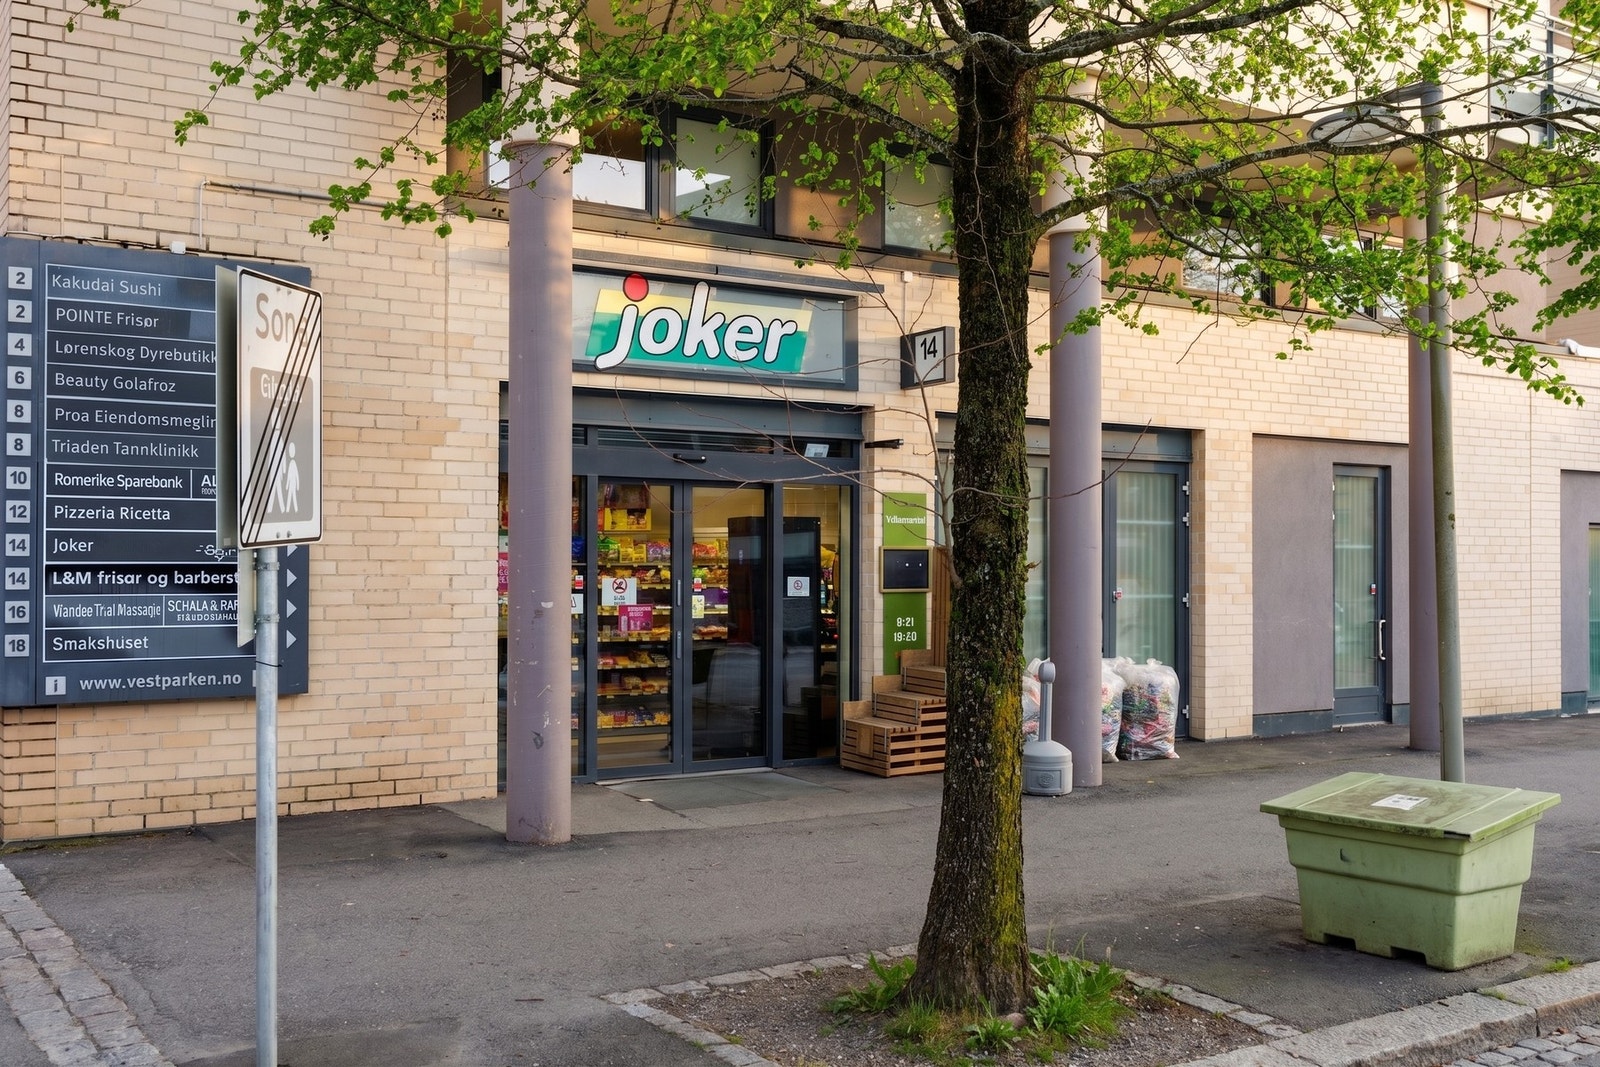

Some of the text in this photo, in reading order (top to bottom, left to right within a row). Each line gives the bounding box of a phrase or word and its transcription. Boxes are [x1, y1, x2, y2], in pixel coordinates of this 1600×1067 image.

[15, 271, 26, 285] 2
[52, 274, 162, 297] Kakudai Sushi
[15, 304, 26, 319] 2
[56, 307, 112, 325] POINTE
[594, 273, 798, 370] joker
[14, 338, 25, 351] 4
[55, 340, 136, 361] Lørenskog
[919, 336, 938, 361] 14
[14, 371, 25, 385] 6
[55, 372, 176, 393] Beauty Golafroz
[14, 404, 24, 418] 8
[55, 408, 90, 422] Proa
[13, 438, 24, 451] 8
[52, 439, 199, 458] Triaden Tannklinikk
[9, 470, 27, 485] 10
[54, 472, 183, 491] Romerike Sparebank
[9, 504, 27, 518] 12
[54, 505, 171, 521] Pizzeria Ricetta
[8, 538, 27, 552] 14
[53, 538, 94, 554] Joker
[8, 571, 26, 585] 14
[53, 571, 91, 585] L&M
[147, 573, 168, 587] og
[8, 605, 26, 619] 16
[8, 639, 26, 652] 18
[52, 636, 149, 651] Smakshuset
[79, 672, 242, 691] www.vestparken.no
